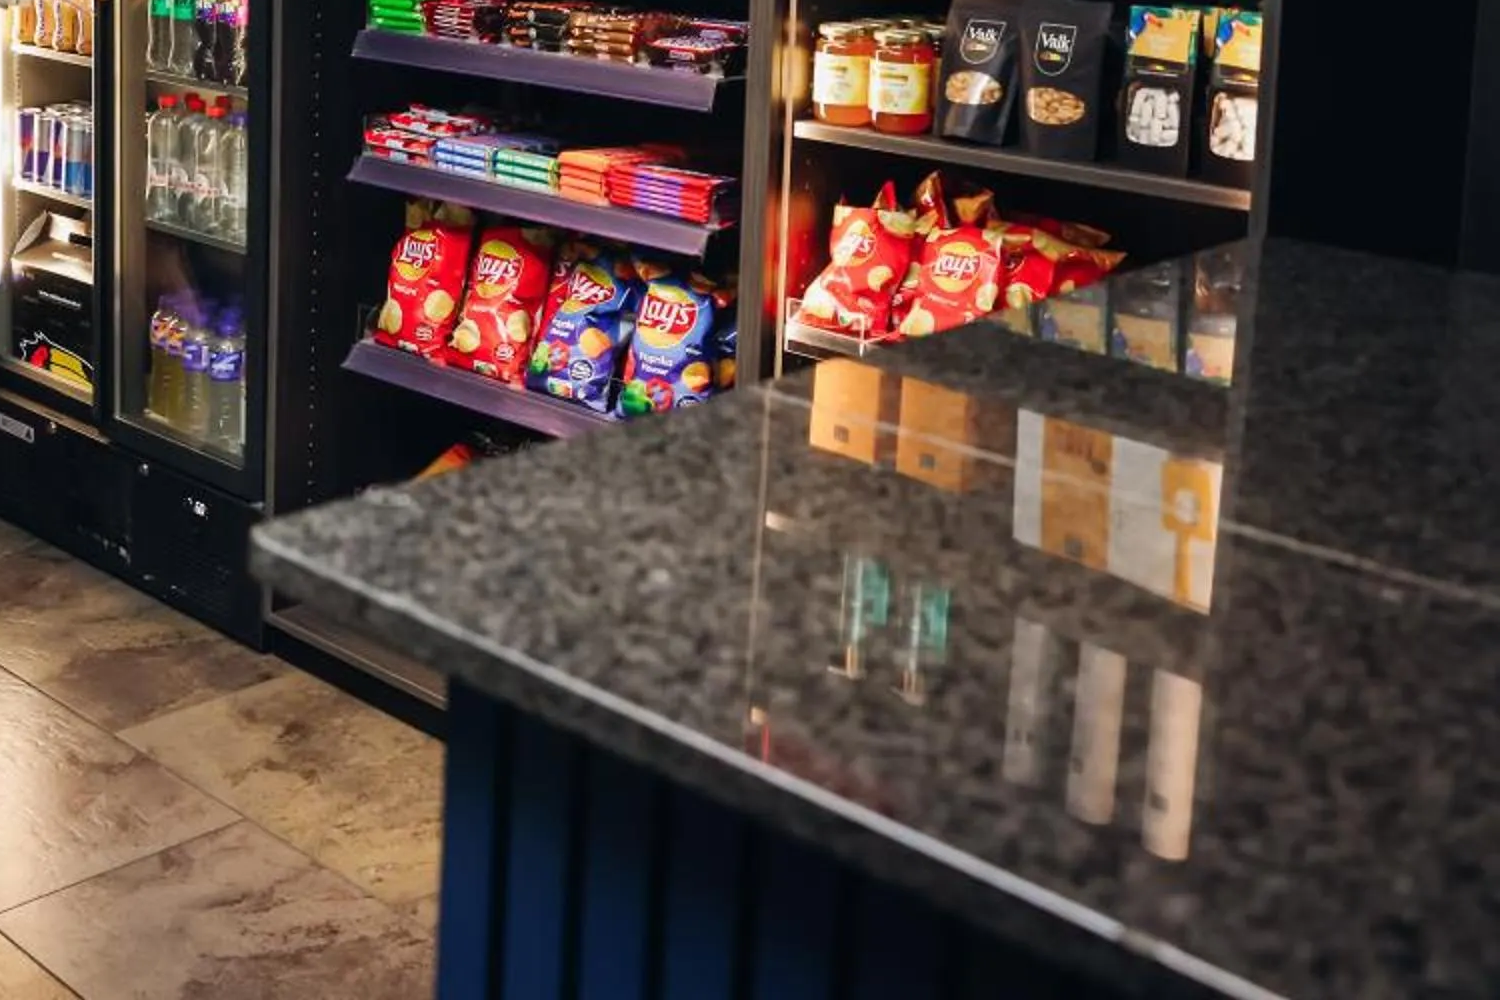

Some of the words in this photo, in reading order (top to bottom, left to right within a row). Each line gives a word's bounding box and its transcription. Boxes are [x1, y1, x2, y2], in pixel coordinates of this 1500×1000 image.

[969, 26, 999, 41] Valk
[1041, 32, 1071, 53] Valk
[399, 235, 436, 269] Lay's
[934, 254, 979, 281] Lay's
[639, 295, 689, 333] Lay's
